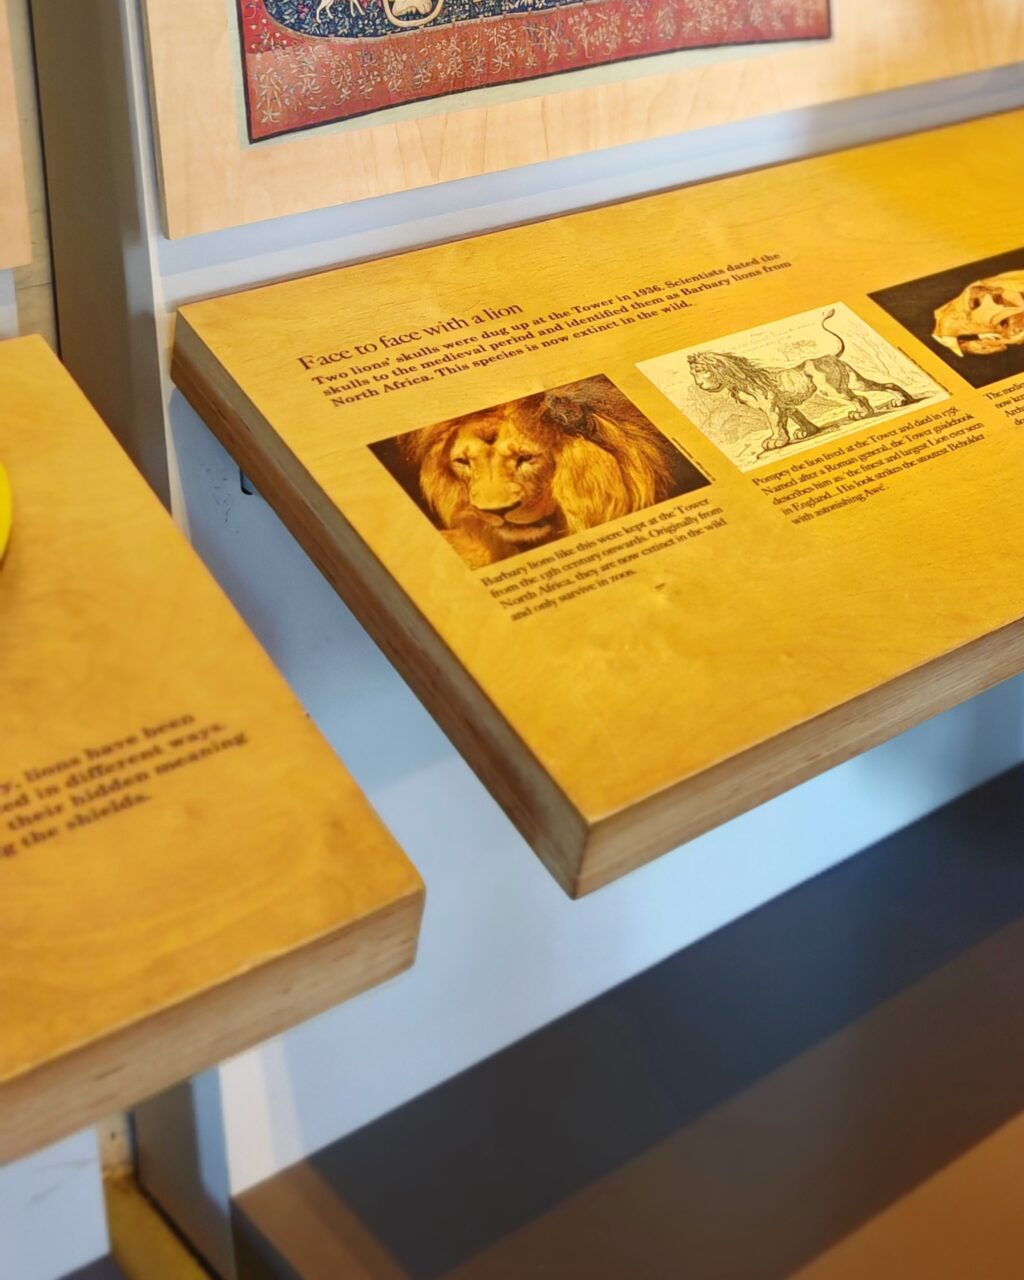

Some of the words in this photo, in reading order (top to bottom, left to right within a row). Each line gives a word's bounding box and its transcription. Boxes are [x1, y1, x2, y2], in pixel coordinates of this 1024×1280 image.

[297, 350, 352, 370] Face
[354, 343, 378, 355] to
[379, 331, 422, 348] face
[422, 317, 470, 336] with
[471, 314, 484, 324] a
[482, 305, 523, 320] lion
[311, 372, 348, 384] Two
[349, 357, 390, 375] lions'
[395, 346, 440, 363] skulls
[441, 336, 478, 349] were
[481, 327, 510, 339] dug
[510, 322, 529, 331] up
[532, 317, 547, 325] at
[547, 311, 571, 320] the
[570, 298, 613, 313] Tower
[615, 294, 632, 302] in
[632, 284, 665, 297] 1936.
[664, 269, 725, 288] Scientists
[726, 258, 760, 271] dated
[760, 254, 780, 262] the
[323, 378, 370, 396] skulls
[391, 366, 418, 376] the
[419, 344, 487, 369] medieval
[488, 330, 536, 351] period
[537, 323, 564, 336] and
[564, 305, 629, 328] identified
[630, 297, 664, 310] them
[679, 278, 730, 295] Barbary
[730, 270, 762, 281] lions
[762, 262, 791, 272] from
[330, 388, 380, 407] North
[383, 375, 434, 393] Africa.
[433, 364, 470, 376] This
[472, 348, 524, 367] species
[540, 335, 568, 347] now
[572, 321, 619, 338] extinct
[636, 310, 659, 320] the
[660, 300, 692, 313] wild.
[751, 469, 791, 486] Pompey
[790, 463, 806, 472] the
[803, 457, 824, 467] lion
[821, 447, 846, 460] lived
[854, 440, 870, 448] the
[867, 429, 898, 443] Tower
[898, 422, 915, 433] and
[914, 415, 933, 427] died
[761, 477, 798, 496] Named
[798, 471, 818, 482] after
[823, 457, 858, 472] Roman
[889, 439, 905, 448] the
[904, 429, 932, 442] Tower
[932, 413, 974, 434] guidebook
[480, 566, 527, 587] Barbary
[526, 556, 556, 570] lions
[553, 548, 576, 559] like
[575, 541, 597, 551] this
[596, 530, 624, 543] were
[621, 521, 647, 534] kept
[647, 517, 659, 525] at
[658, 511, 676, 521] the
[674, 498, 709, 514] Tower
[6, 803, 64, 830] their
[69, 771, 150, 807] hidden
[154, 732, 248, 775] meaning
[24, 757, 81, 782] lions
[83, 735, 138, 760] have
[141, 714, 195, 739] been
[35, 785, 61, 798] in
[65, 744, 164, 788] different
[20, 827, 59, 847] the
